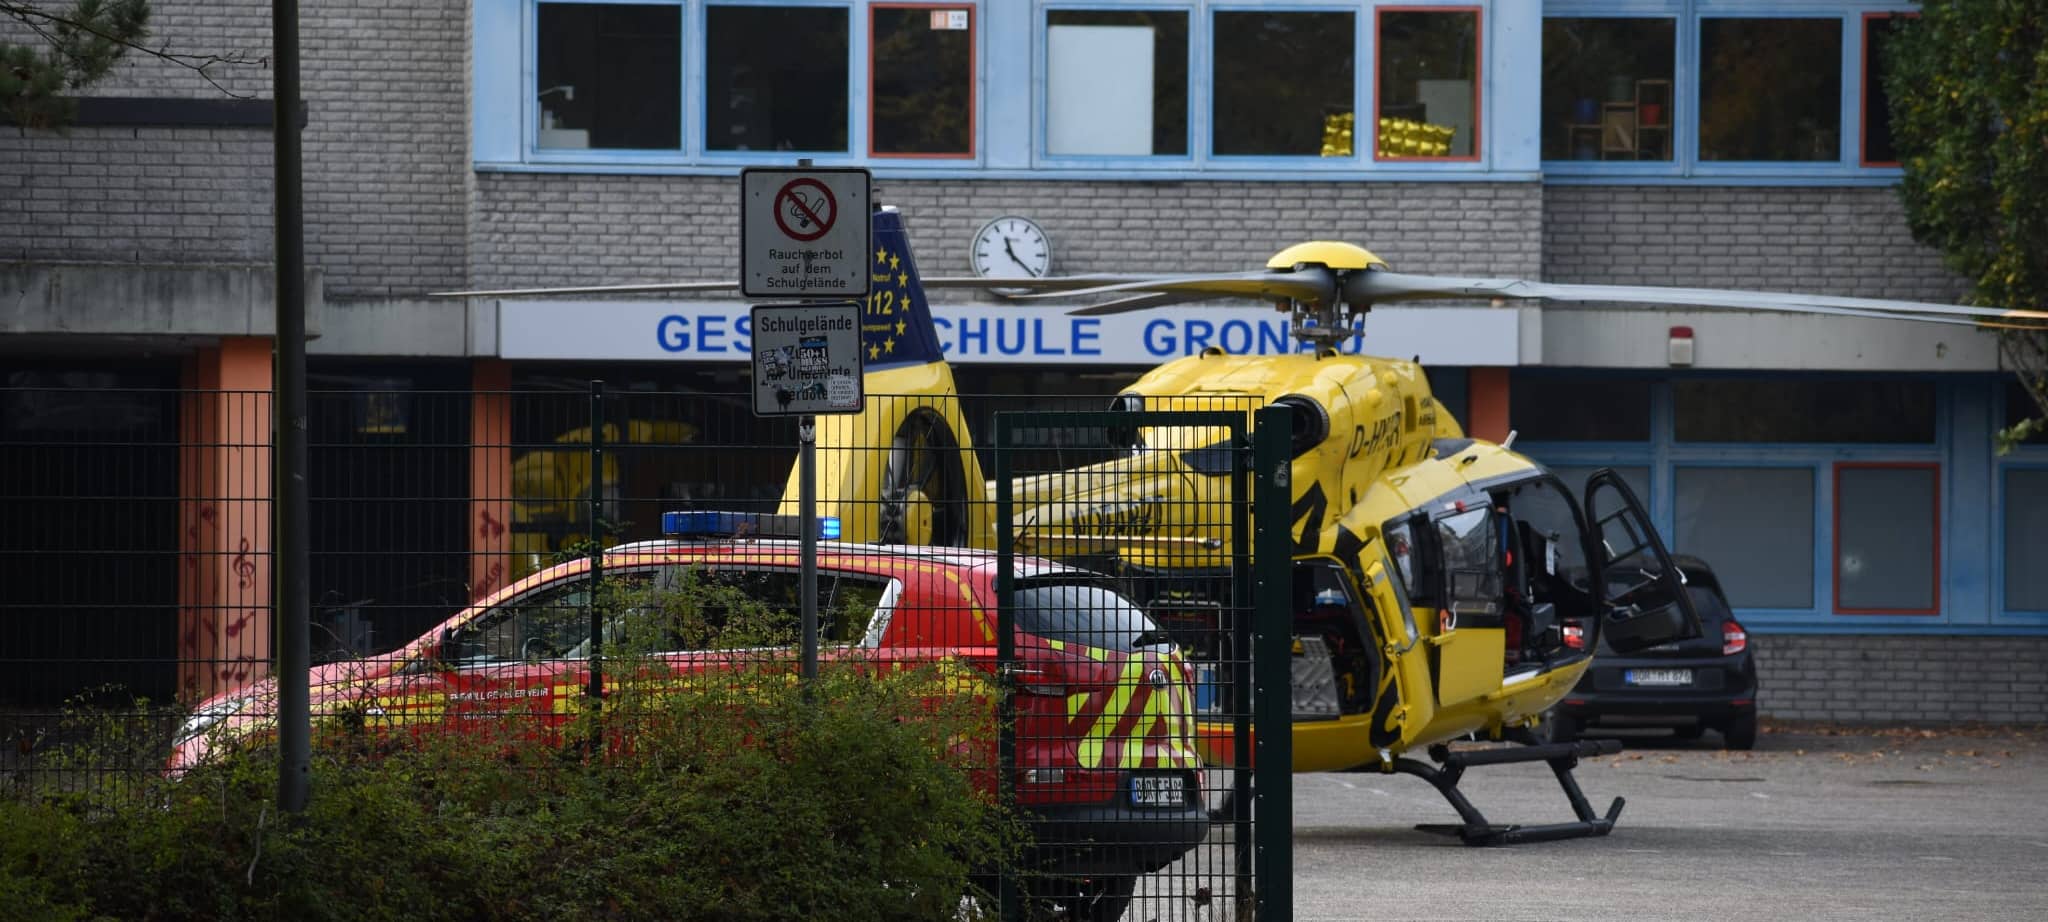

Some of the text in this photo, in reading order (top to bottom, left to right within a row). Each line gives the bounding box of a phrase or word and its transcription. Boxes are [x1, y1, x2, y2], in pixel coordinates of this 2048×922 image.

[769, 249, 843, 260] Raucherbot
[782, 263, 831, 274] auf dem
[767, 277, 847, 291] Schulgelände
[866, 291, 893, 315] 112
[761, 315, 852, 335] Schulgelände
